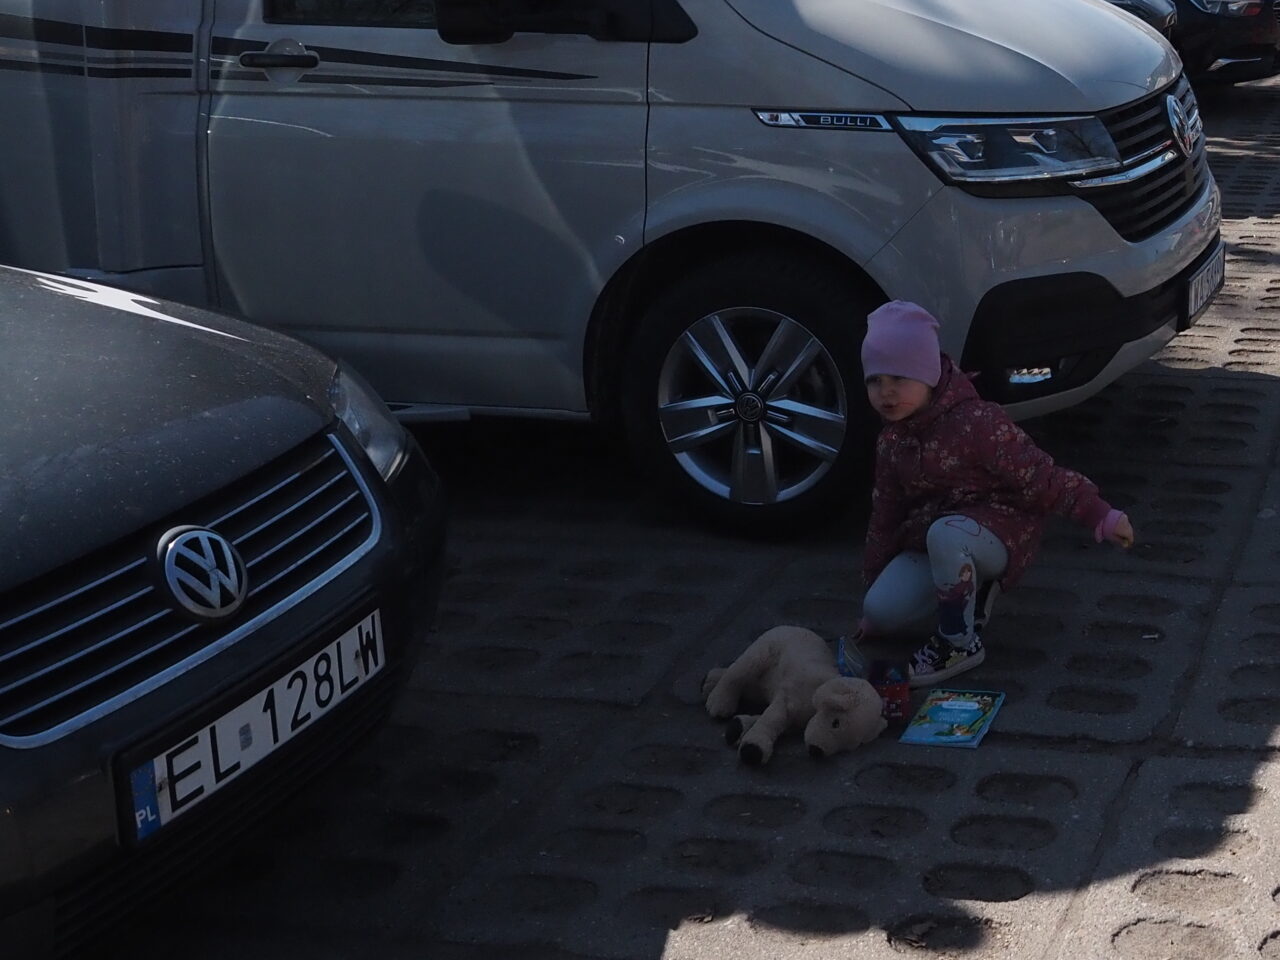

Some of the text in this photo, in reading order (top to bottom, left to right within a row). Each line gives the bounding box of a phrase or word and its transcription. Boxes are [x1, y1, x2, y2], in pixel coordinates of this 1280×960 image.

[820, 116, 870, 125] BULLI
[165, 614, 379, 812] EL 128LW
[135, 805, 156, 829] PL
